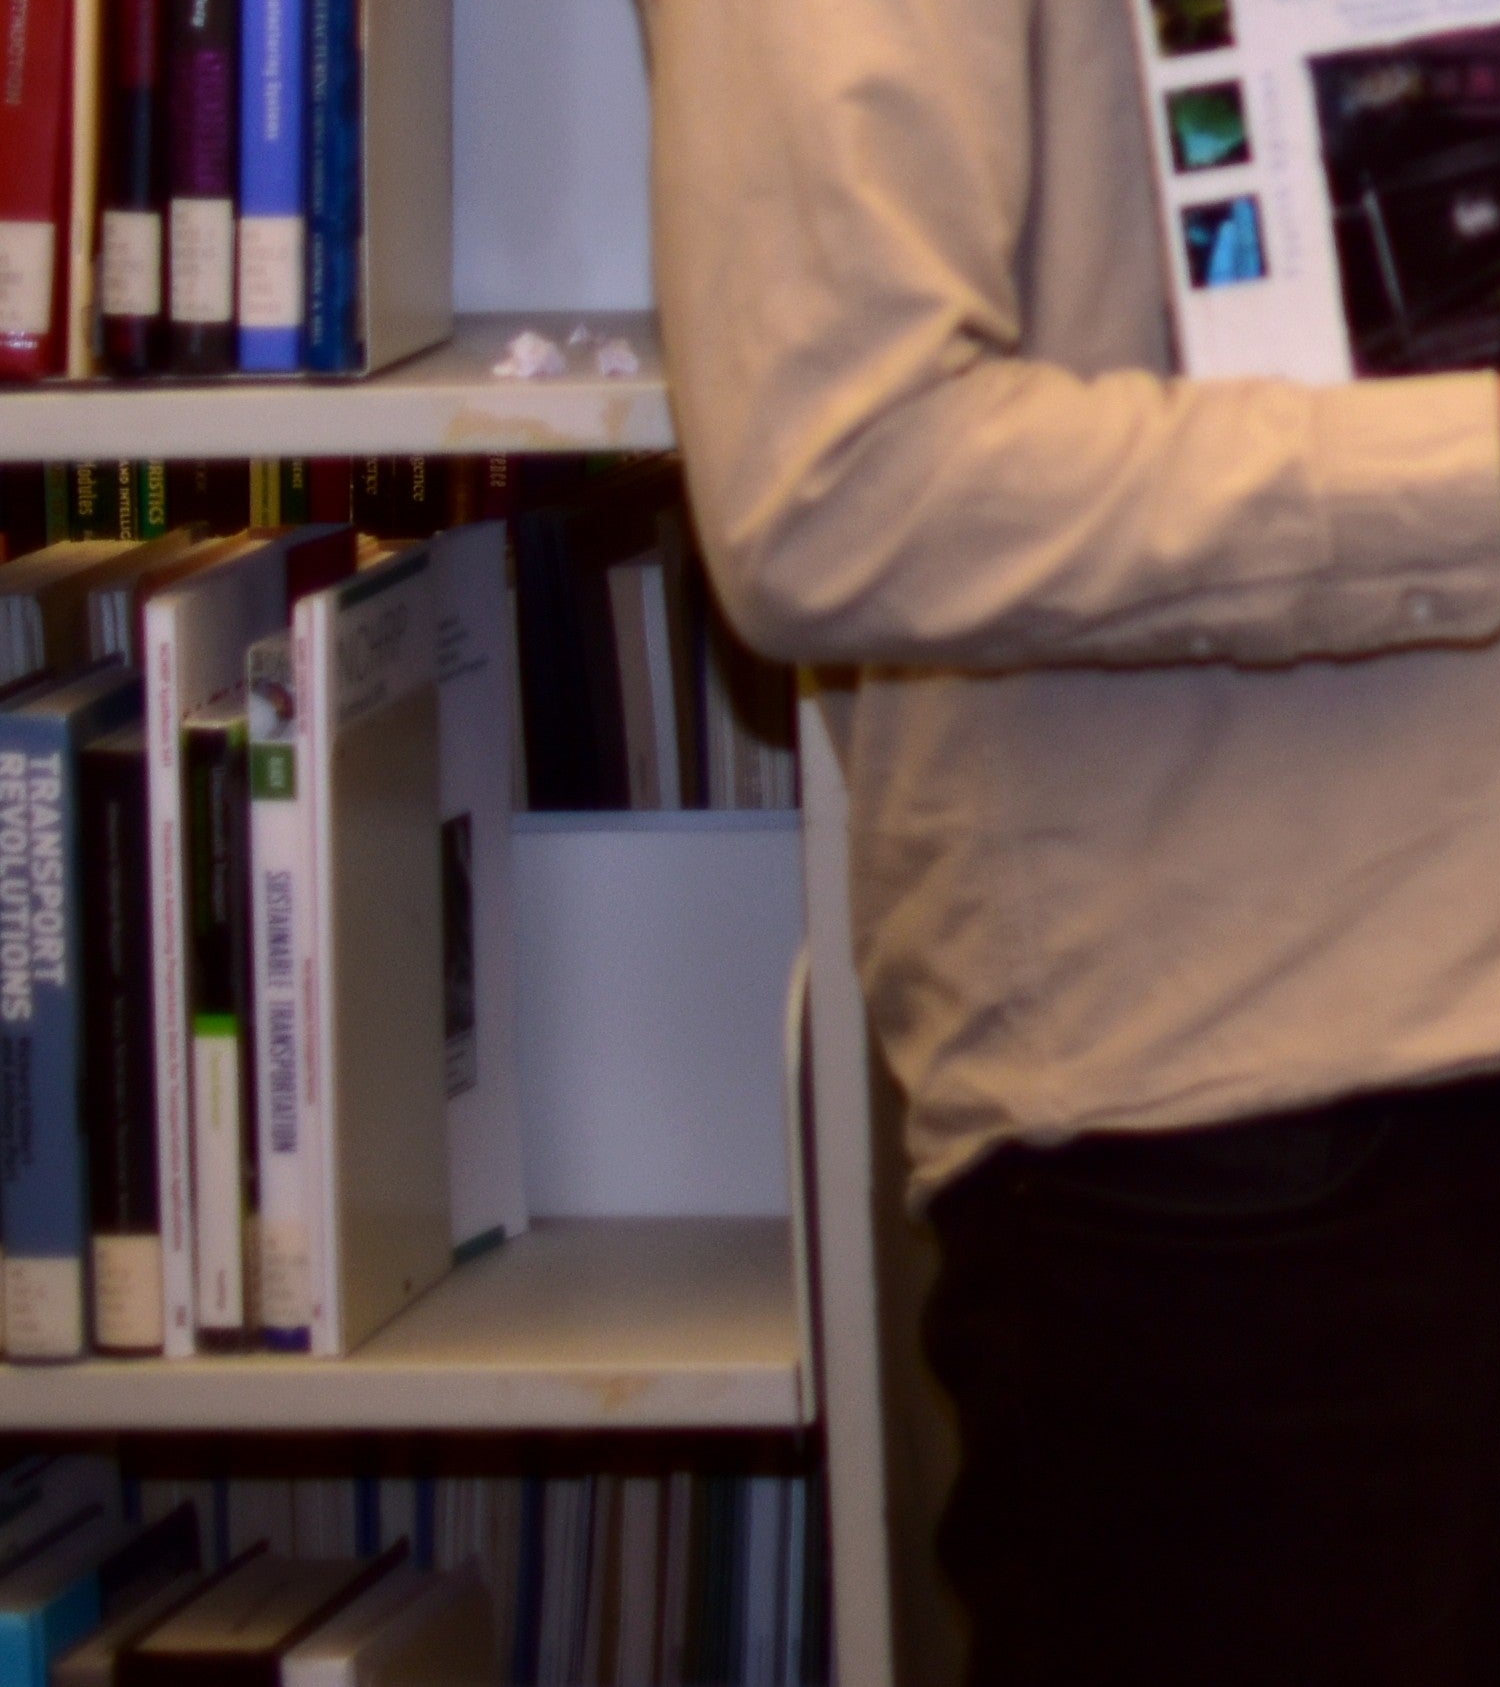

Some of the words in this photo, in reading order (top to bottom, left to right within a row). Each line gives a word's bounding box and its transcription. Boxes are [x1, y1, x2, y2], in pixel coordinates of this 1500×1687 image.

[0, 752, 31, 1021] REVOLUTIONS
[31, 752, 66, 987] TRANSPORT
[265, 871, 295, 989] SUSTAINABLE
[268, 1000, 298, 1155] TRANSPORTATION
